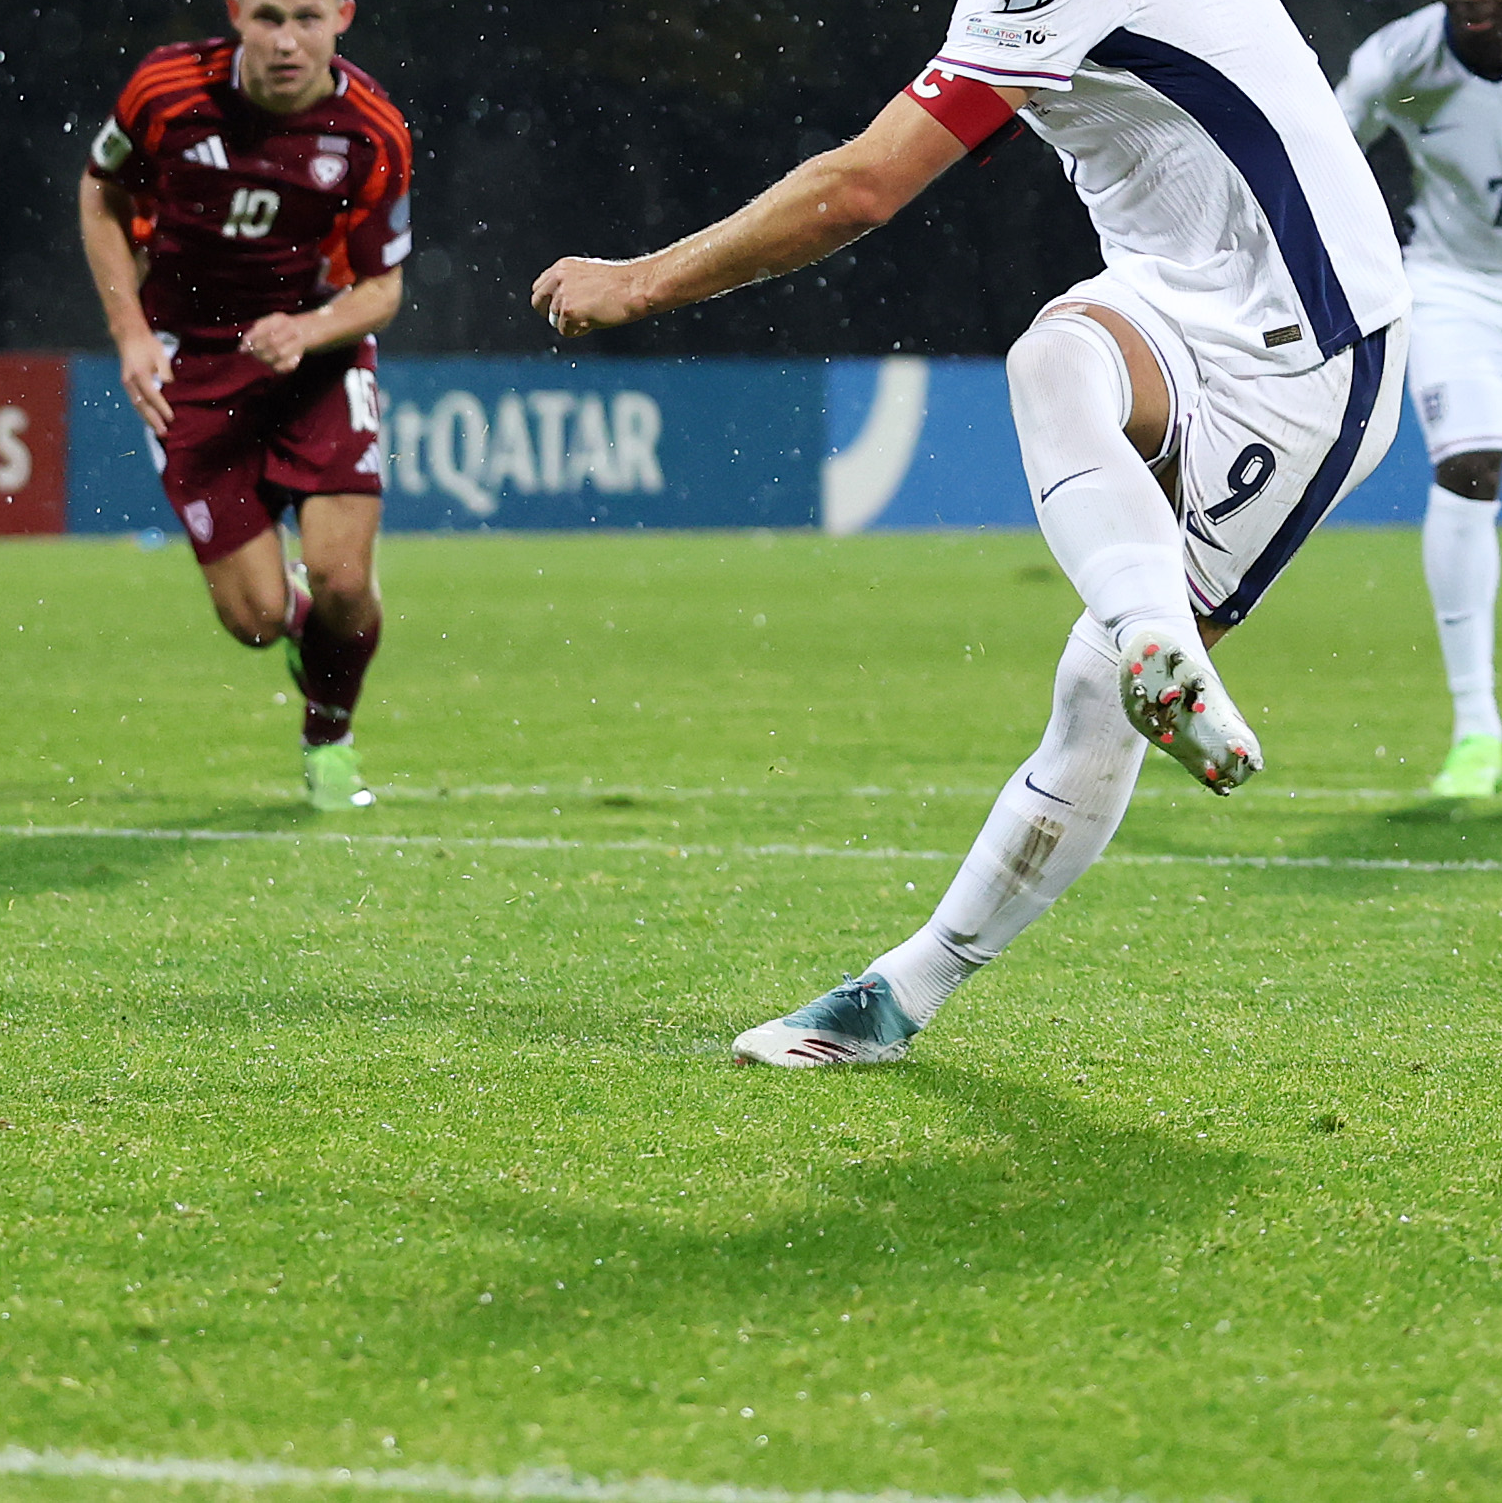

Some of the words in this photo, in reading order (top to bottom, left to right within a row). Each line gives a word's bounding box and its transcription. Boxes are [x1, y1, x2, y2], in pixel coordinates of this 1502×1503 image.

[966, 25, 1022, 40] FOUNDATION
[912, 66, 955, 99] C
[222, 186, 282, 239] 10
[1202, 442, 1277, 526] 9
